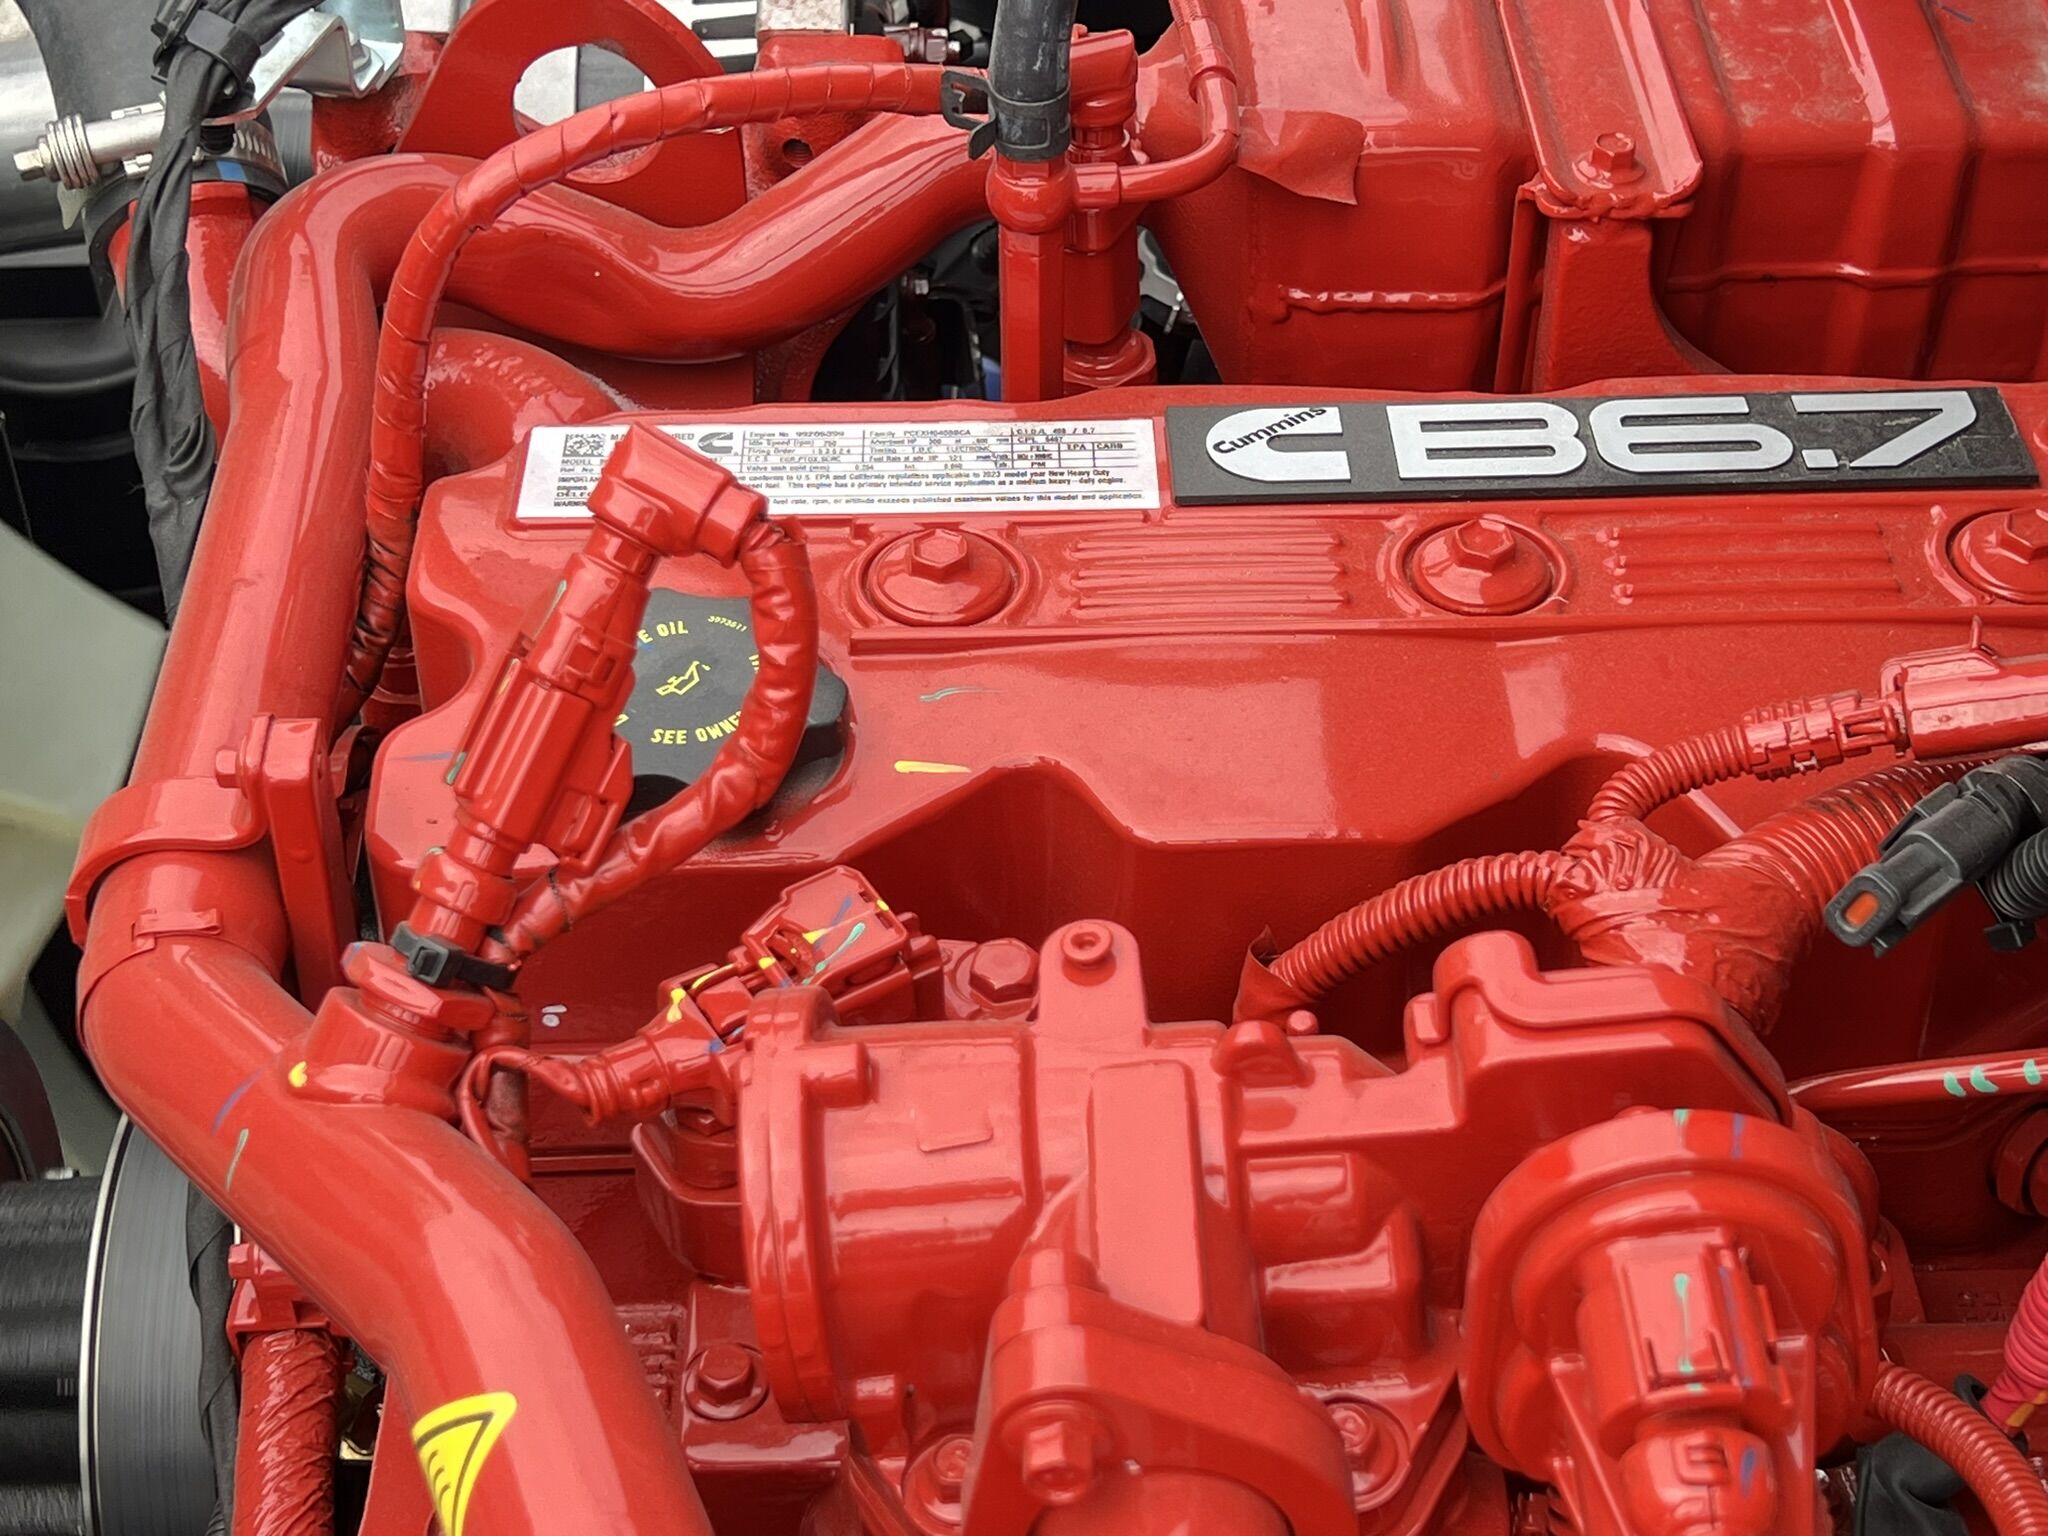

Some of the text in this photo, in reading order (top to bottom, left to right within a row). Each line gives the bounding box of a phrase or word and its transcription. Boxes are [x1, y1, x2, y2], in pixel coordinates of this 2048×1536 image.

[750, 431, 775, 440] Engine
[870, 430, 896, 438] Family
[1212, 406, 1327, 454] Cummins
[1386, 390, 1978, 479] B6.7
[766, 439, 791, 448] Speed
[748, 447, 772, 456] Firing
[561, 458, 592, 466] MODEL
[849, 472, 885, 480] California
[888, 472, 930, 481] regulations
[932, 472, 970, 481] applicable
[1030, 470, 1046, 479] year
[1048, 469, 1064, 477] New
[1067, 468, 1090, 478] Heavy
[1093, 468, 1110, 477] Duty
[806, 481, 833, 490] engine
[857, 481, 887, 489] primary
[954, 479, 996, 488] application
[913, 496, 952, 506] published
[1024, 494, 1035, 502] for
[1054, 493, 1079, 501] model
[656, 620, 689, 637] OIL
[650, 710, 742, 745] SEE OWNE
